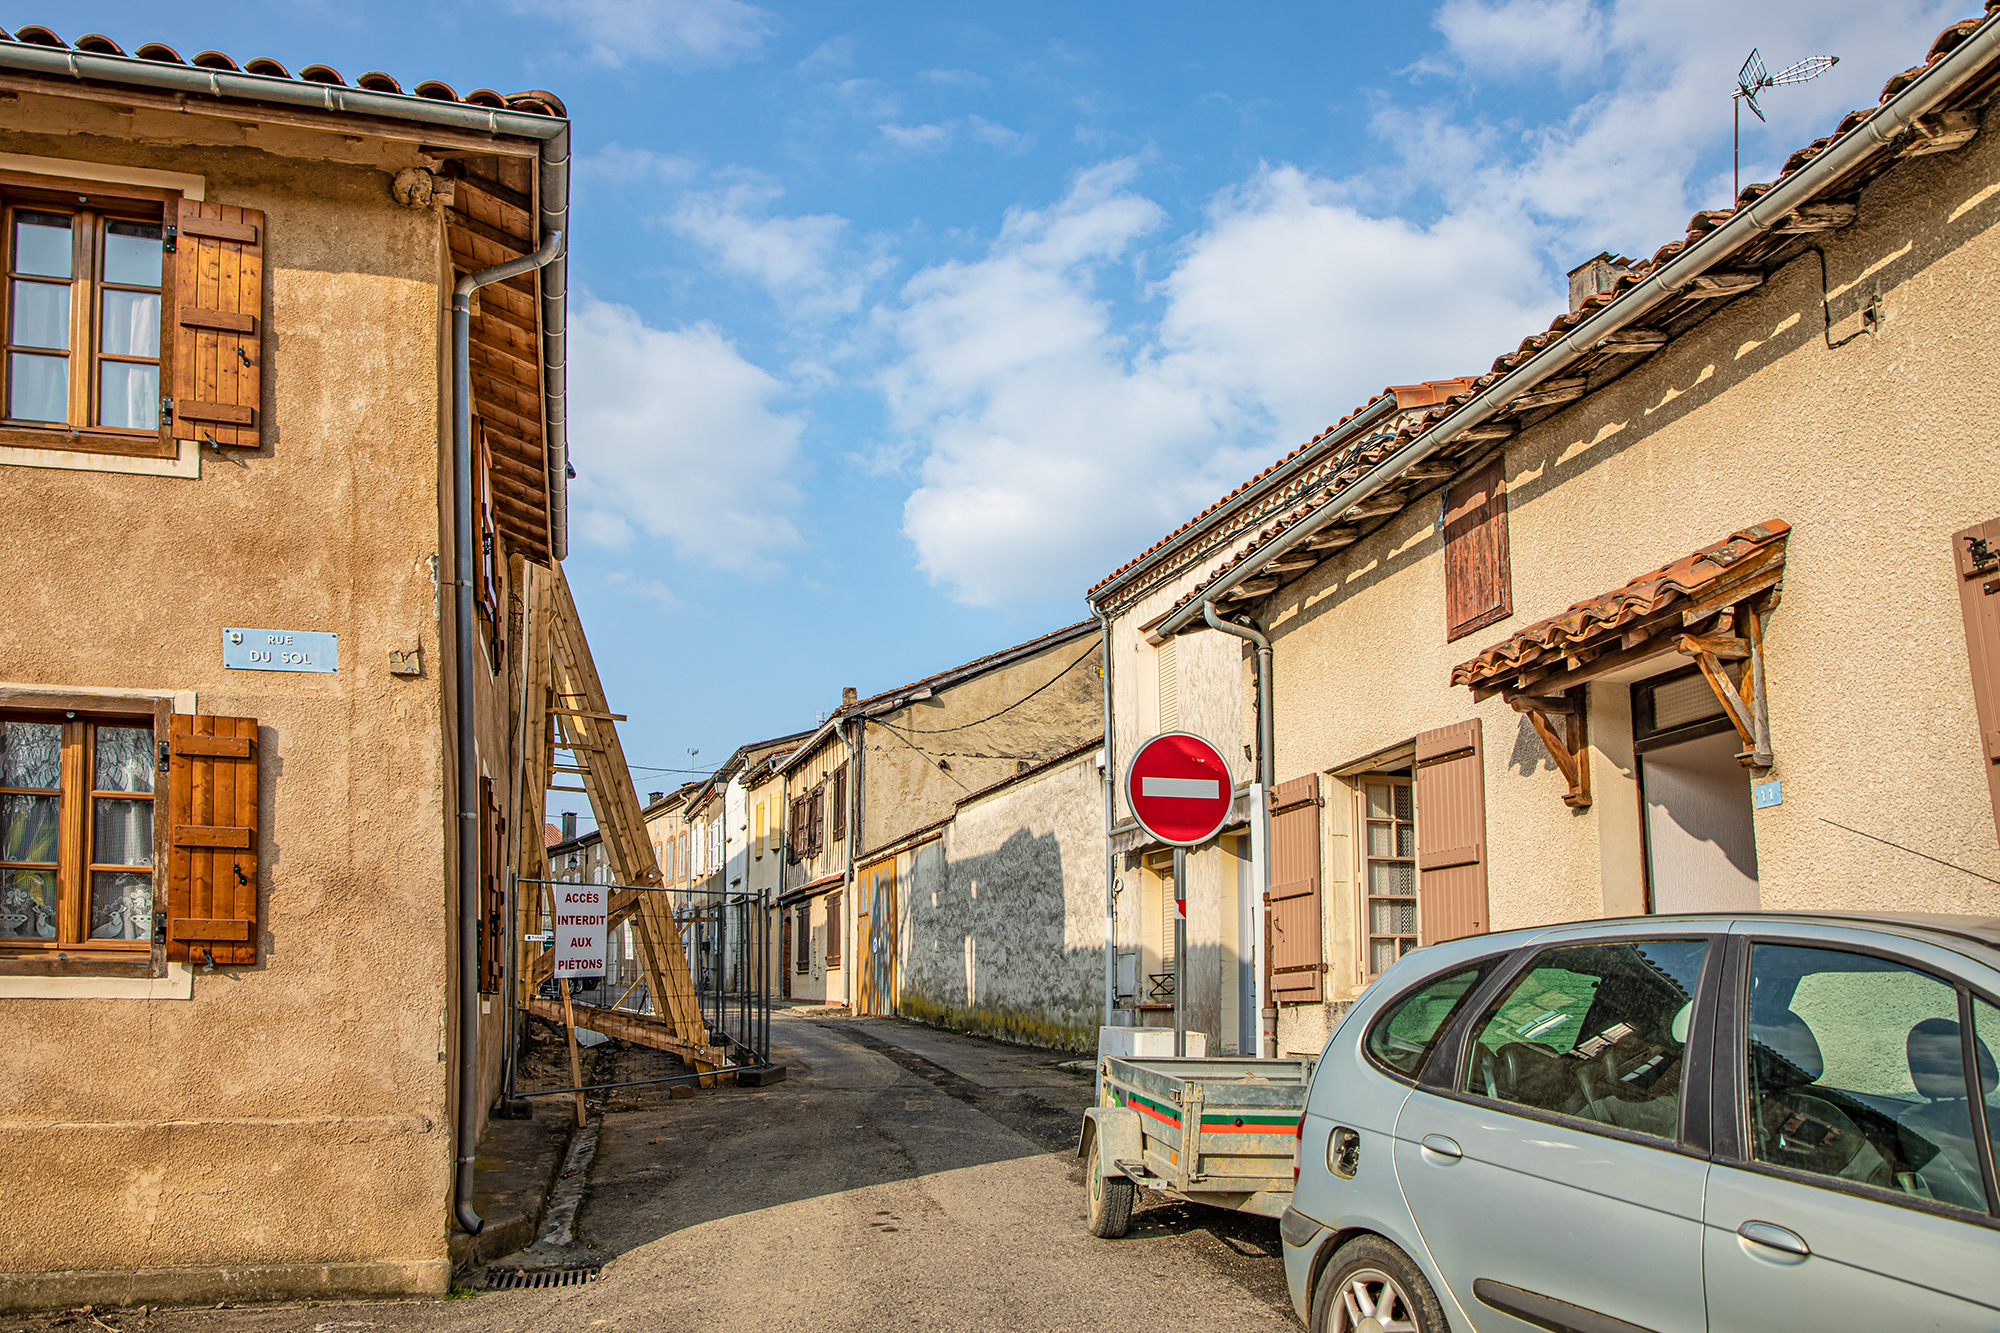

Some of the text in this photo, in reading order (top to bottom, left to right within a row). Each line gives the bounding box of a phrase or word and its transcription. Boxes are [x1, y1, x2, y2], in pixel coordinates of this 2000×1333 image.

[267, 634, 294, 646] RUE
[249, 649, 312, 665] DU SOL
[1761, 787, 1774, 802] 11
[565, 891, 599, 904] ACCÈS
[557, 915, 606, 926] INTERDIT
[570, 937, 593, 948] AUX
[558, 957, 603, 971] PIÉTONS
